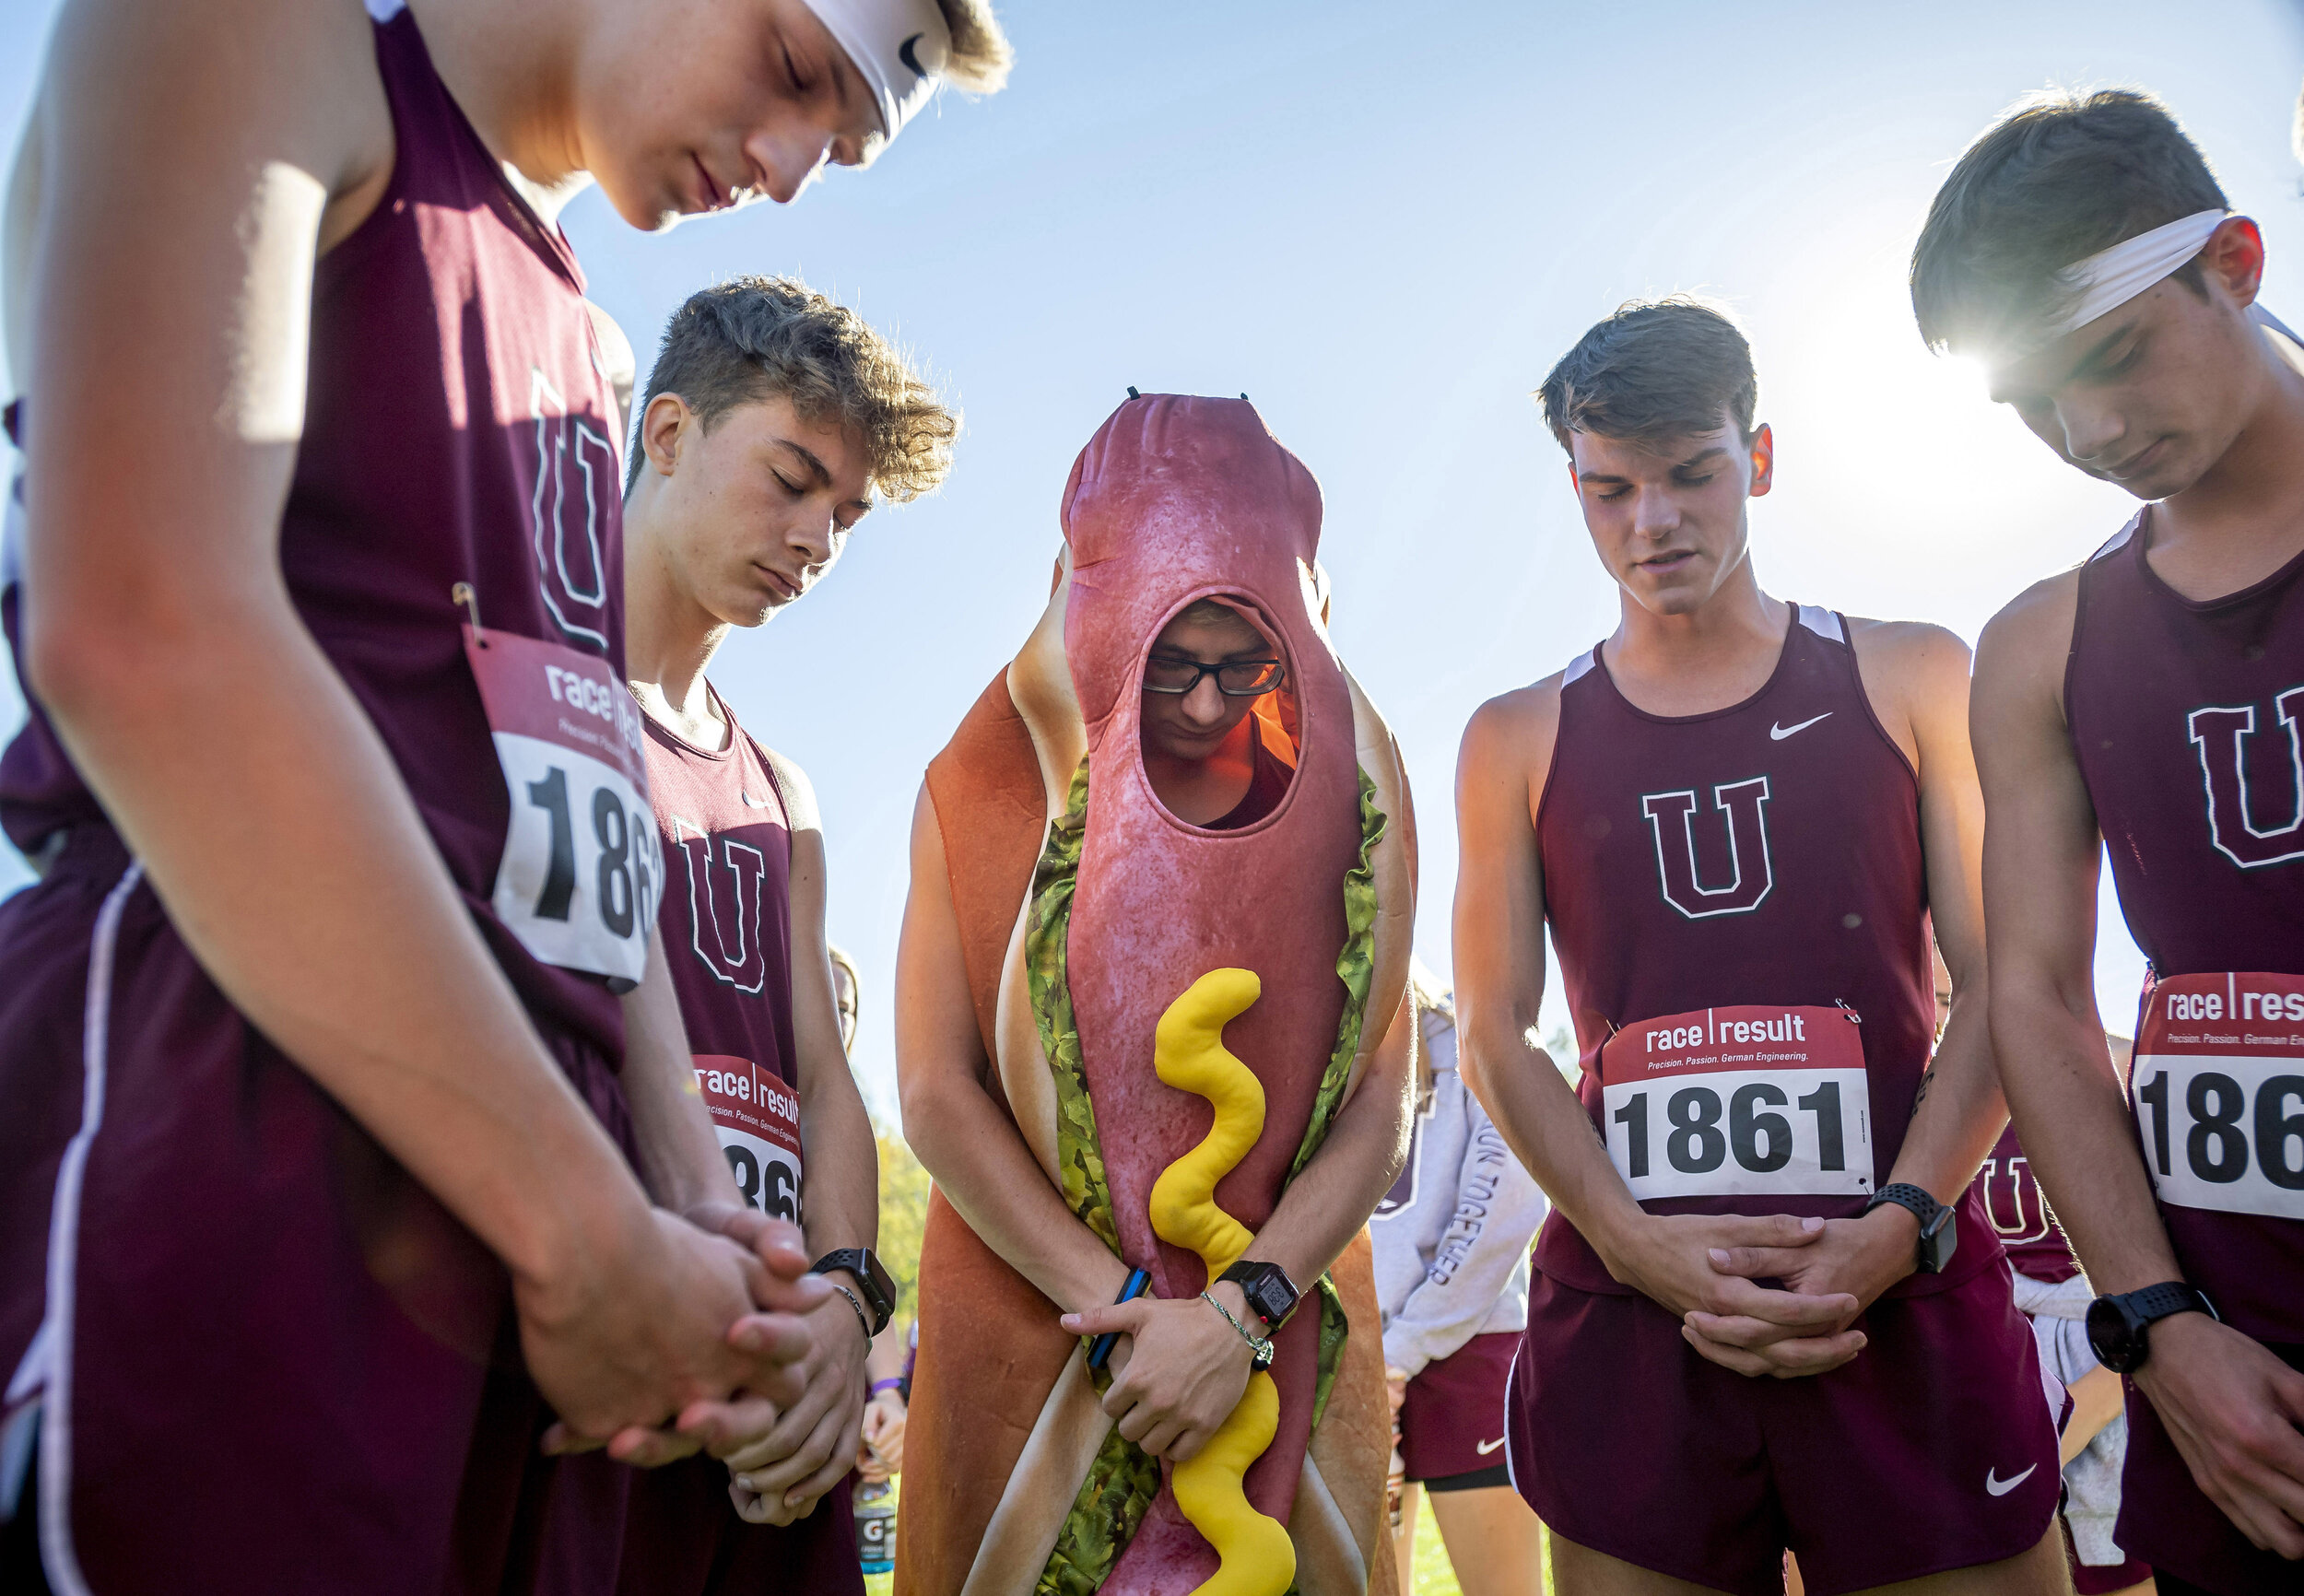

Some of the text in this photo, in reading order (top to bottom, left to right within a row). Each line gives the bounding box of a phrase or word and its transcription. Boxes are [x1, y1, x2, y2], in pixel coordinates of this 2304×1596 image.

[544, 664, 614, 722] race
[2187, 685, 2304, 869] U
[1641, 775, 1773, 919] U
[673, 816, 766, 995] U
[1646, 1013, 1805, 1053] race result
[2167, 992, 2223, 1020] race
[1648, 1051, 1808, 1071] Precision. Passion. German Engineering.
[2167, 1033, 2201, 1044] Precision.
[2203, 1033, 2240, 1044] Passion.
[2243, 1033, 2287, 1045] German
[735, 1110, 759, 1126] Passion.
[1614, 1081, 1846, 1179] 1861
[1428, 1173, 1499, 1286] TOGETHER
[1983, 1156, 2049, 1245] U
[864, 1519, 884, 1542] G
